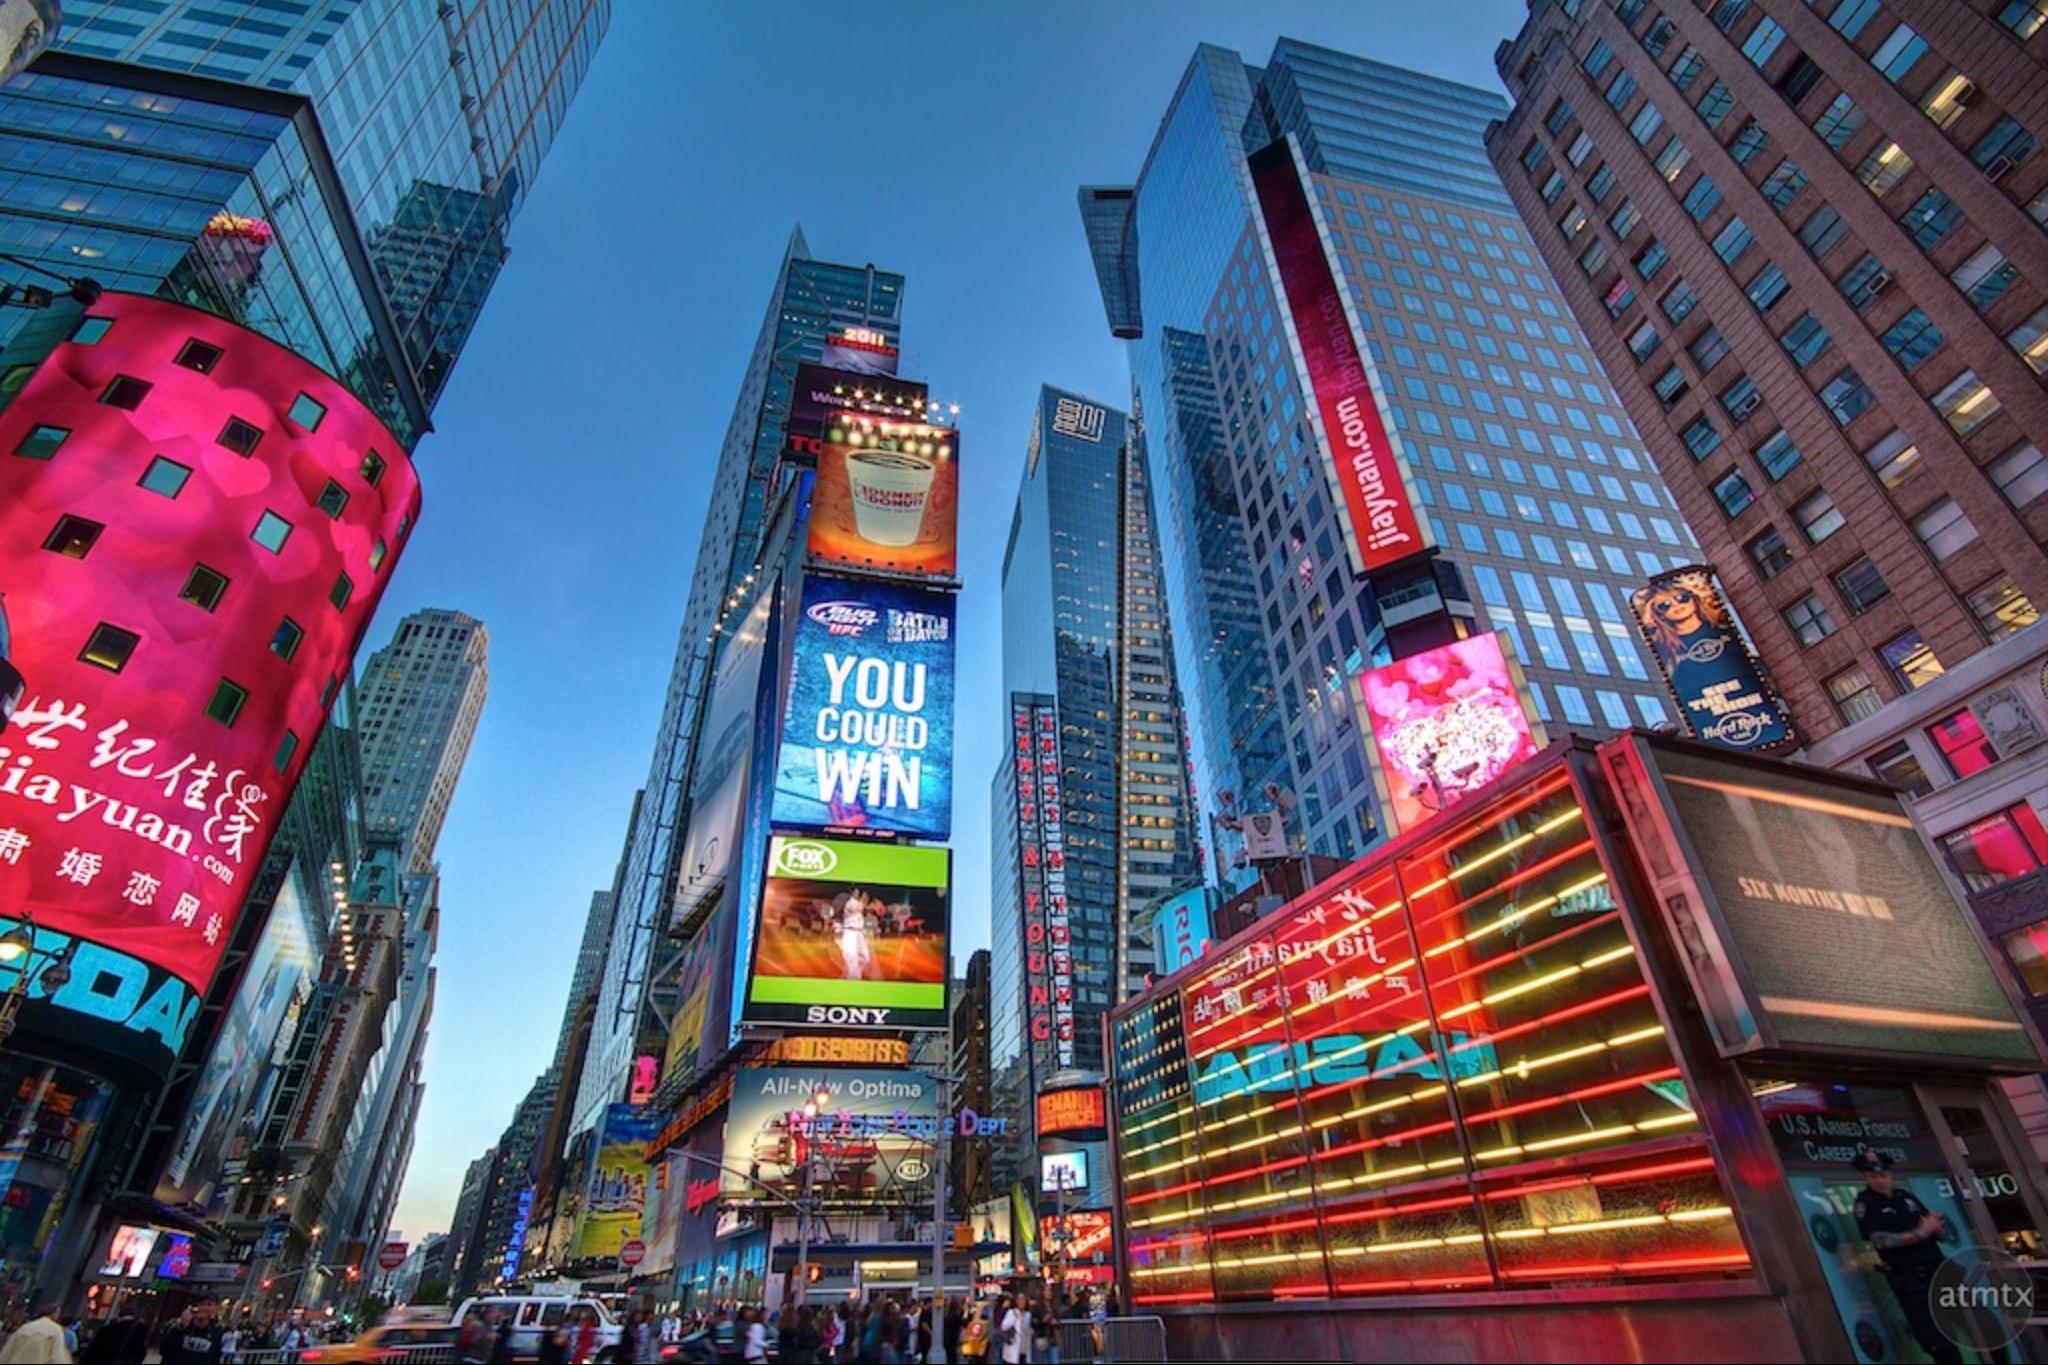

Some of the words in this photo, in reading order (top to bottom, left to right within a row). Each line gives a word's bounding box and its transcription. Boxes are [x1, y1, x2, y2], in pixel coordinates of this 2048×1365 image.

[843, 327, 885, 346] 2011
[1335, 395, 1410, 551] jiayuan.com
[823, 653, 926, 712] YOU
[815, 706, 929, 751] COULD
[815, 747, 921, 810] WIN
[787, 846, 825, 864] FOX
[1738, 877, 1773, 900] SIX
[1025, 892, 1050, 1041] YOUNG
[807, 1006, 891, 1024] SONY
[849, 1078, 923, 1099] Optima
[893, 1108, 954, 1137] POLIE
[960, 1107, 1010, 1136] DEPT
[1778, 1113, 1816, 1135] U.S.
